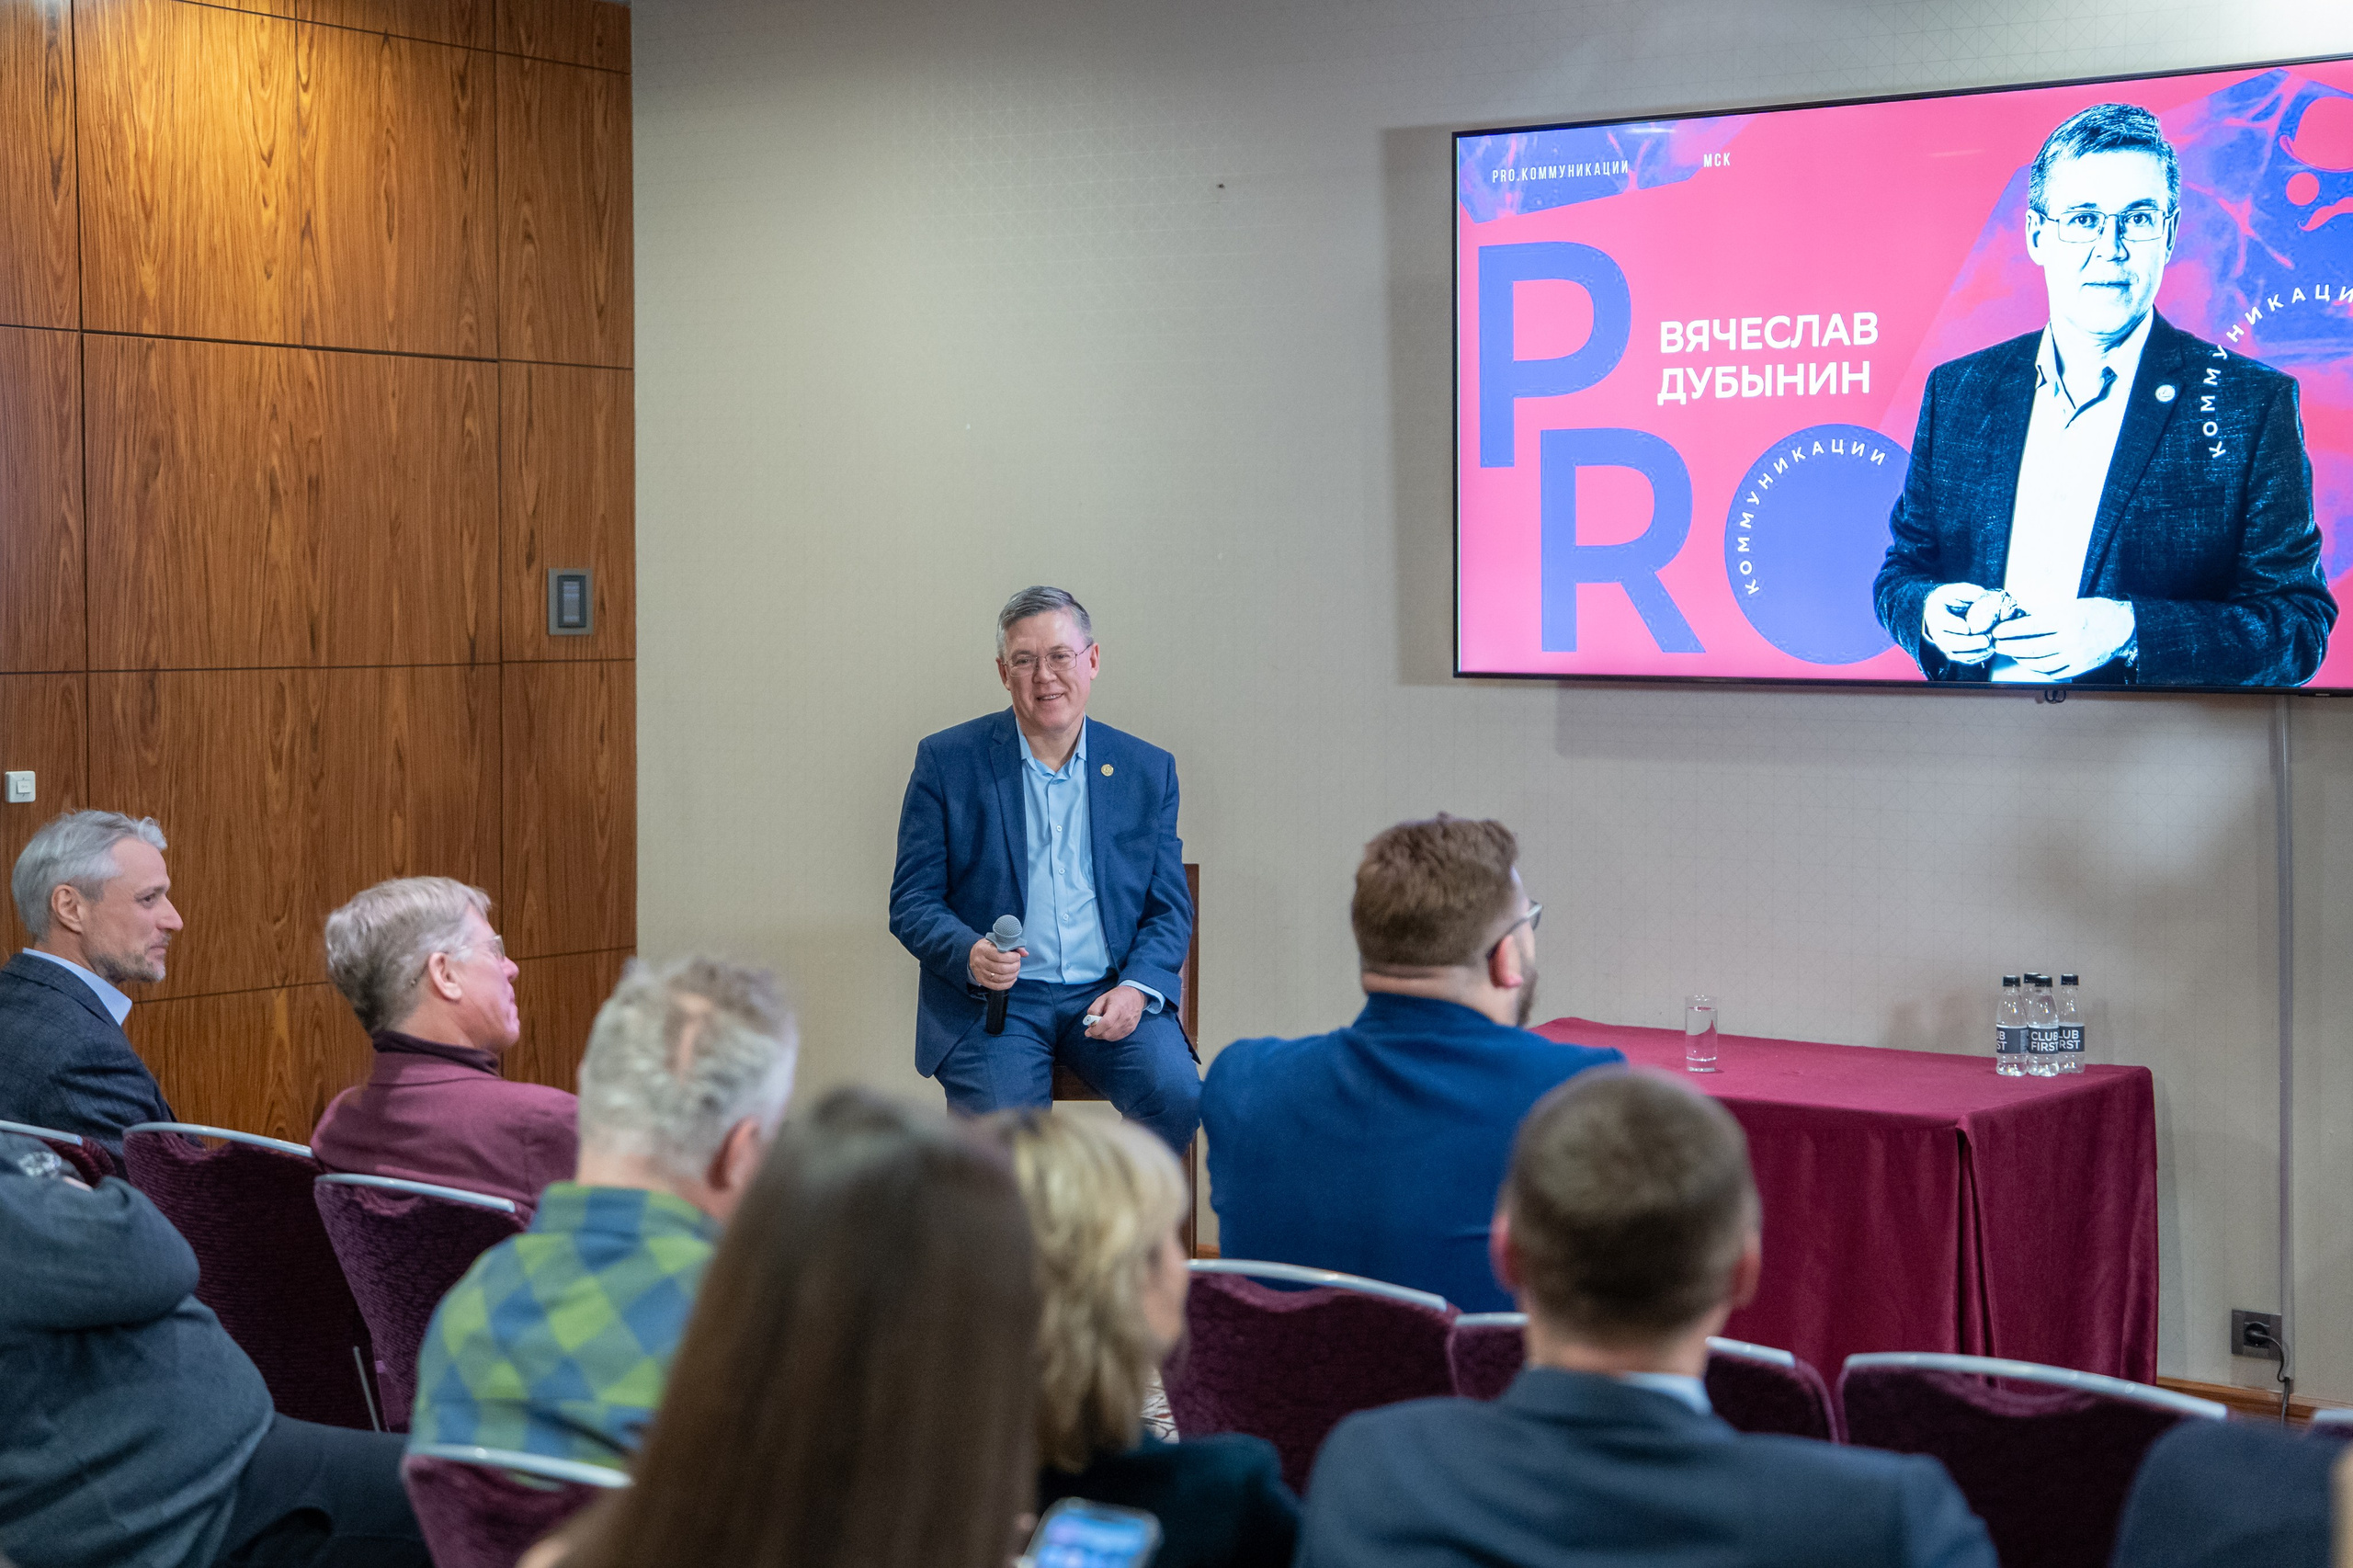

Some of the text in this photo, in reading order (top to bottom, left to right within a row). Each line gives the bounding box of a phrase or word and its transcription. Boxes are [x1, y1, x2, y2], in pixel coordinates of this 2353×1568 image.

[1492, 159, 1629, 183] PRO.КОММУНИКАЦИИ
[1703, 153, 1732, 167] МСК
[1659, 312, 1879, 354] ВЯЧЕСЛАВ
[1657, 360, 1871, 405] ДУБЫНИН
[1737, 438, 1885, 595] КОММУНИКАЦИИ
[2030, 1030, 2059, 1041] CLUB
[2030, 1040, 2059, 1051] FIRST
